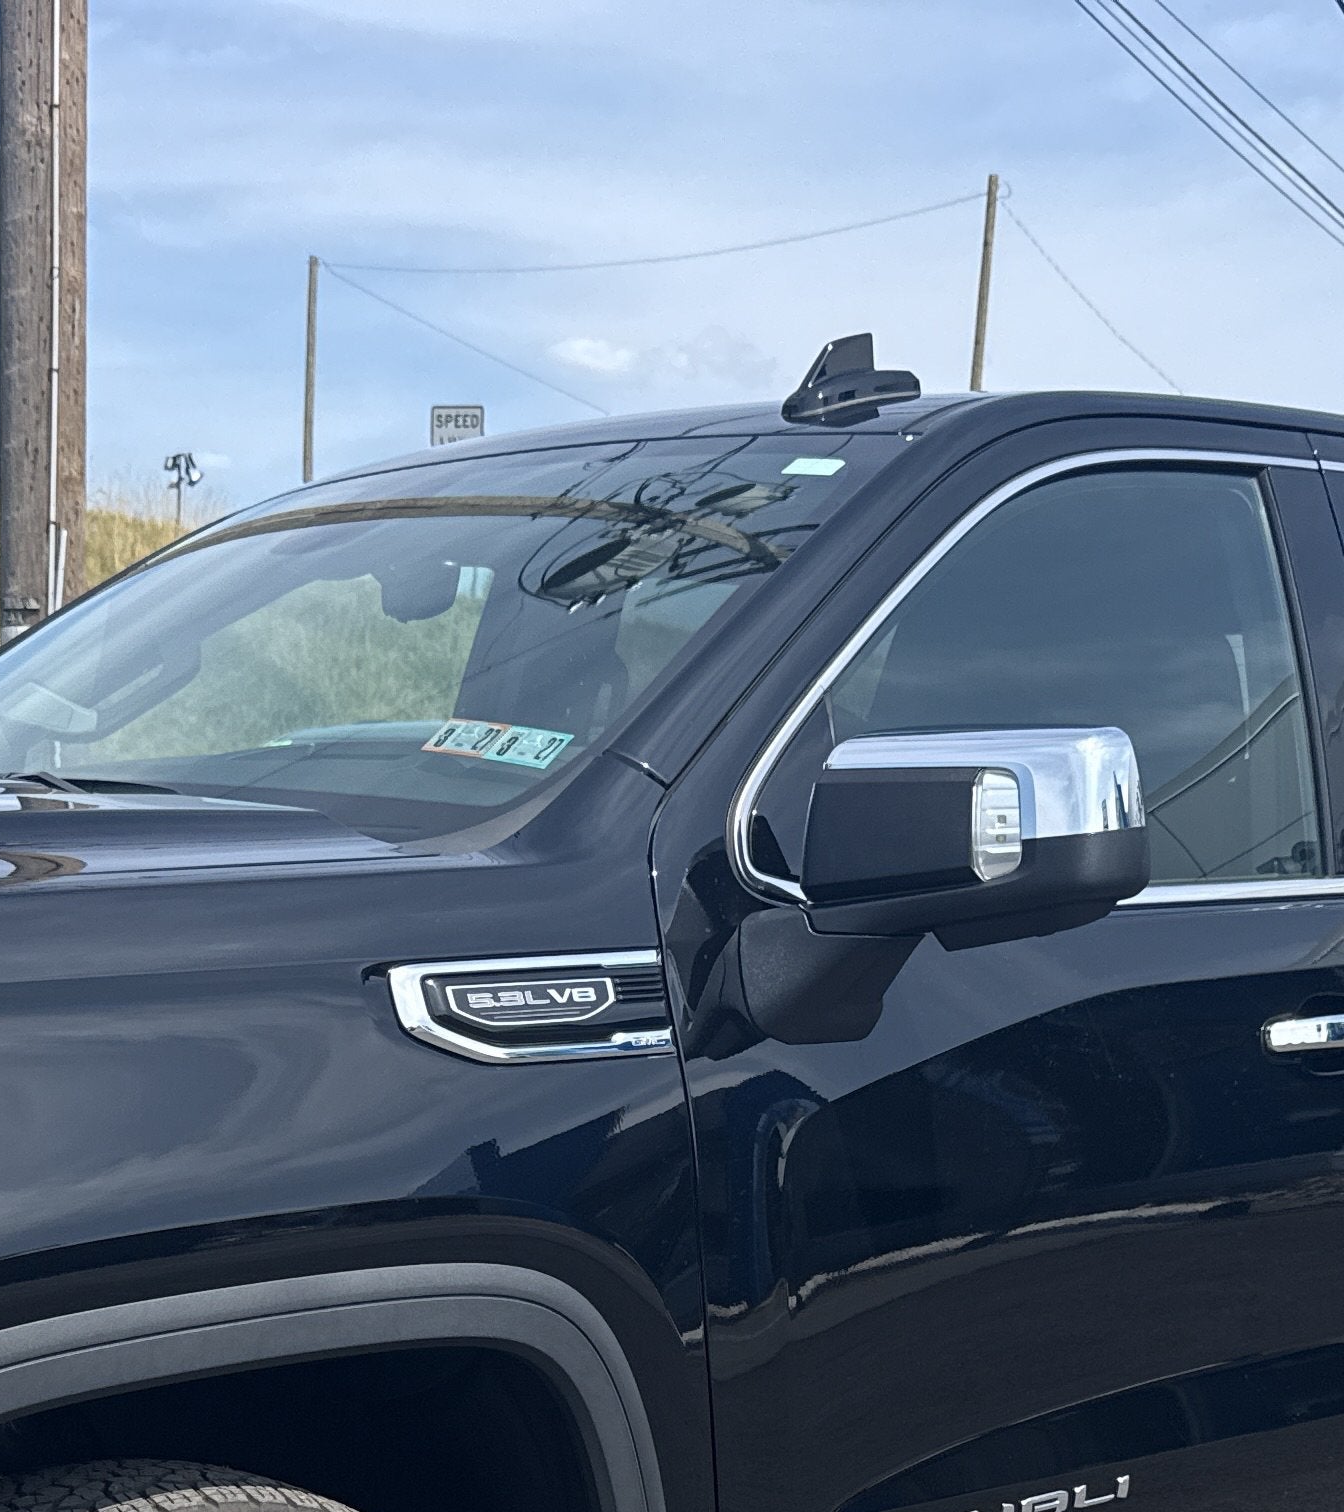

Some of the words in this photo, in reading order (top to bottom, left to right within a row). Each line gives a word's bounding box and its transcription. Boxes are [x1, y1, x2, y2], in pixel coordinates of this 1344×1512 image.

[435, 413, 480, 429] SPEED
[433, 728, 456, 747] 3
[495, 736, 519, 756] 3
